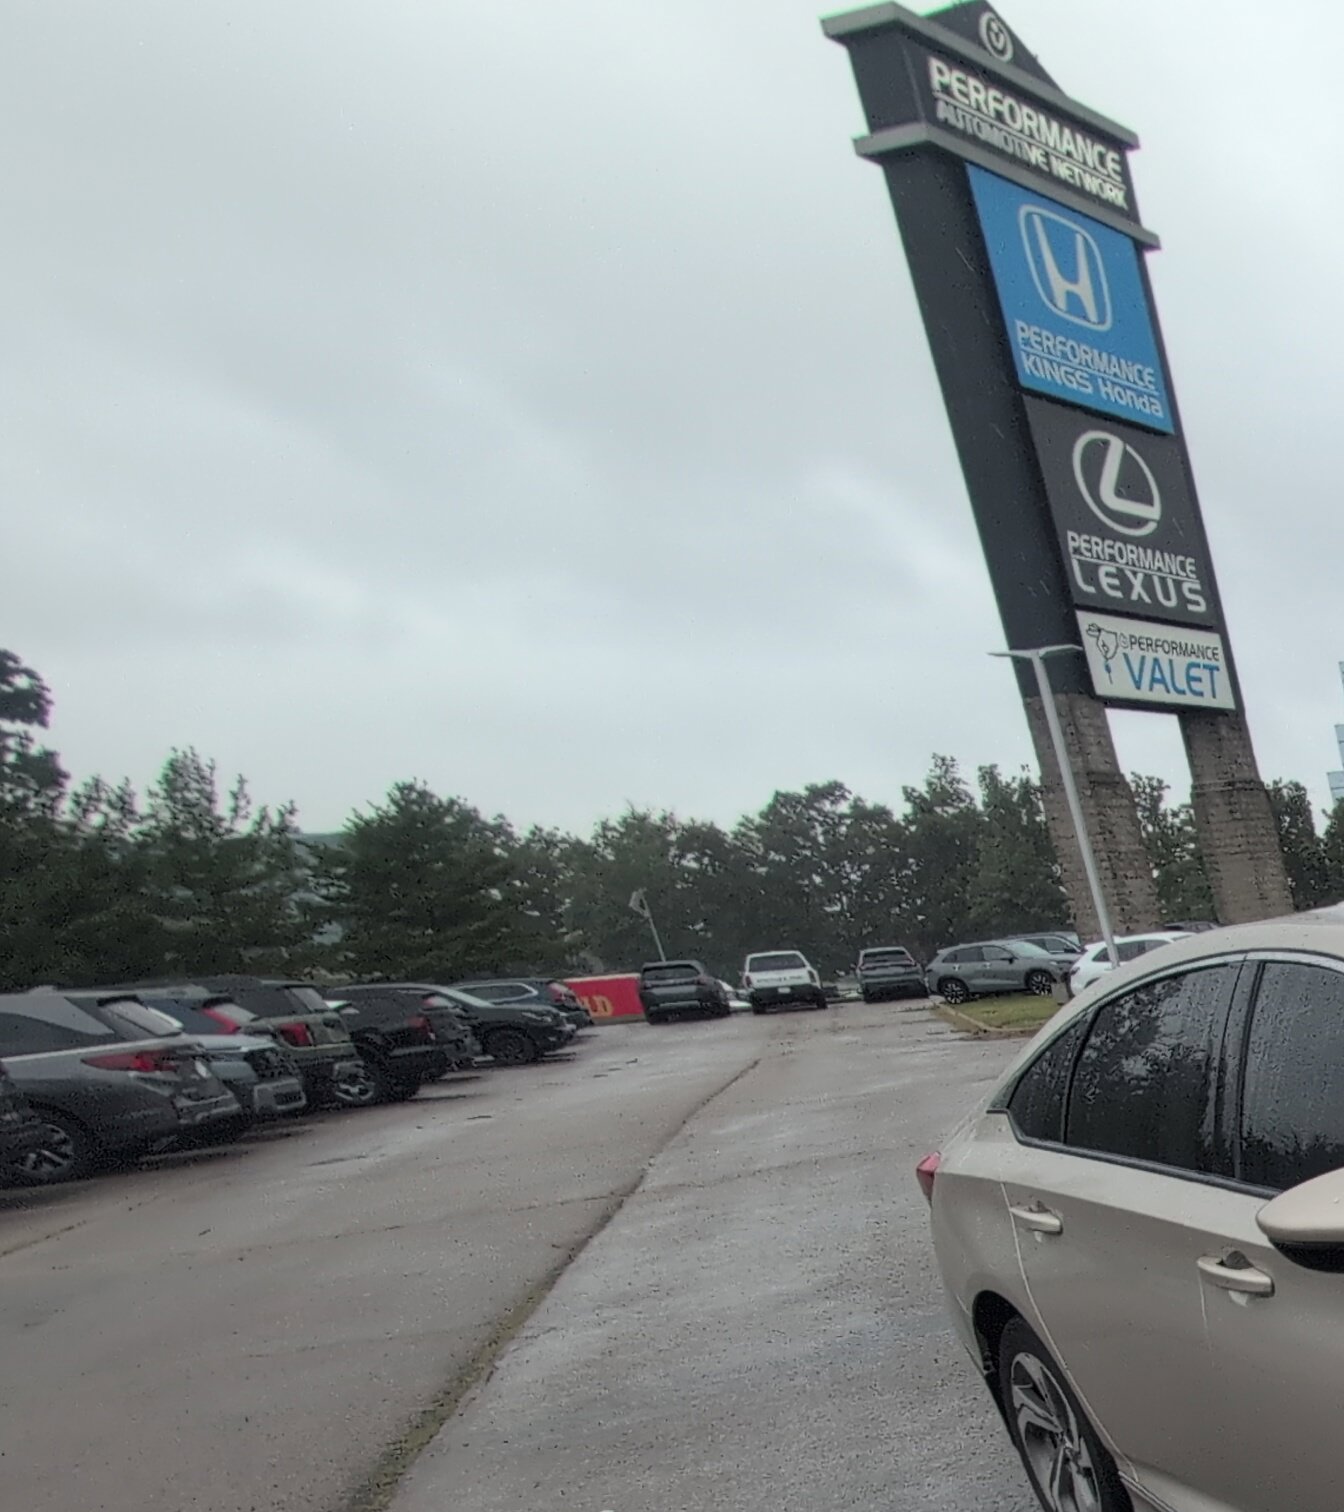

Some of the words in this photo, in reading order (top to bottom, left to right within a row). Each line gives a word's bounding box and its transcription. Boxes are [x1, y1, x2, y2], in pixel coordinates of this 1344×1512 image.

[928, 56, 1123, 182] PERFORMANCE
[936, 100, 1049, 172] AUTOMOTIVE
[1050, 156, 1128, 211] NETWORK
[1015, 319, 1157, 391] PERFORMANCE
[1020, 351, 1093, 395] KINGS
[1067, 530, 1197, 579] PERFORMANCE
[1072, 558, 1207, 613] LEXUS
[1129, 634, 1219, 662] PERFORMANCE
[1123, 652, 1220, 699] VALET
